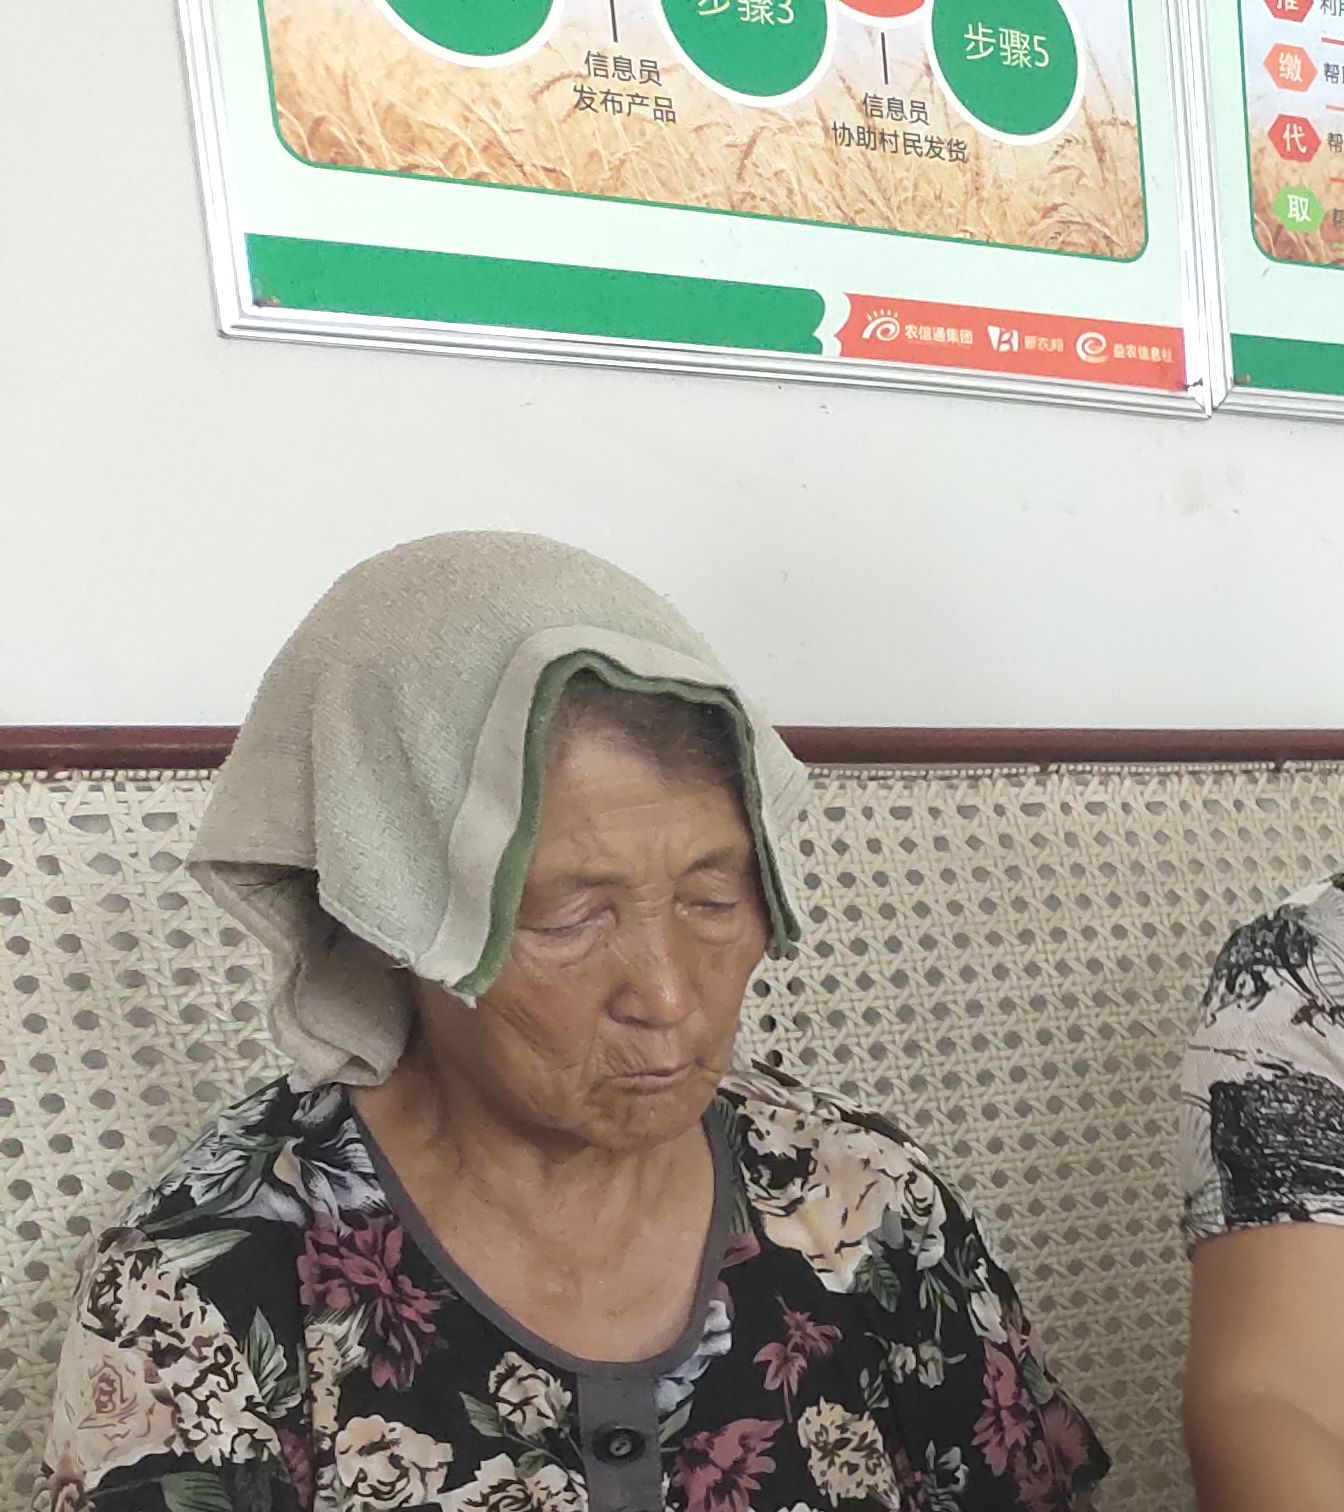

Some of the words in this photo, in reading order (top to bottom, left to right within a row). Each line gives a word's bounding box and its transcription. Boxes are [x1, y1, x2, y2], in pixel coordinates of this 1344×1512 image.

[963, 21, 1051, 69] 步骤5
[584, 50, 661, 86] 信息员
[1278, 53, 1303, 82] 缴
[572, 85, 677, 124] 发布产品
[862, 92, 931, 126] 信息员
[831, 122, 969, 164] 协助村民发货
[1283, 123, 1307, 153] 代
[1287, 194, 1312, 223] 取
[904, 323, 973, 346] 农信通集团
